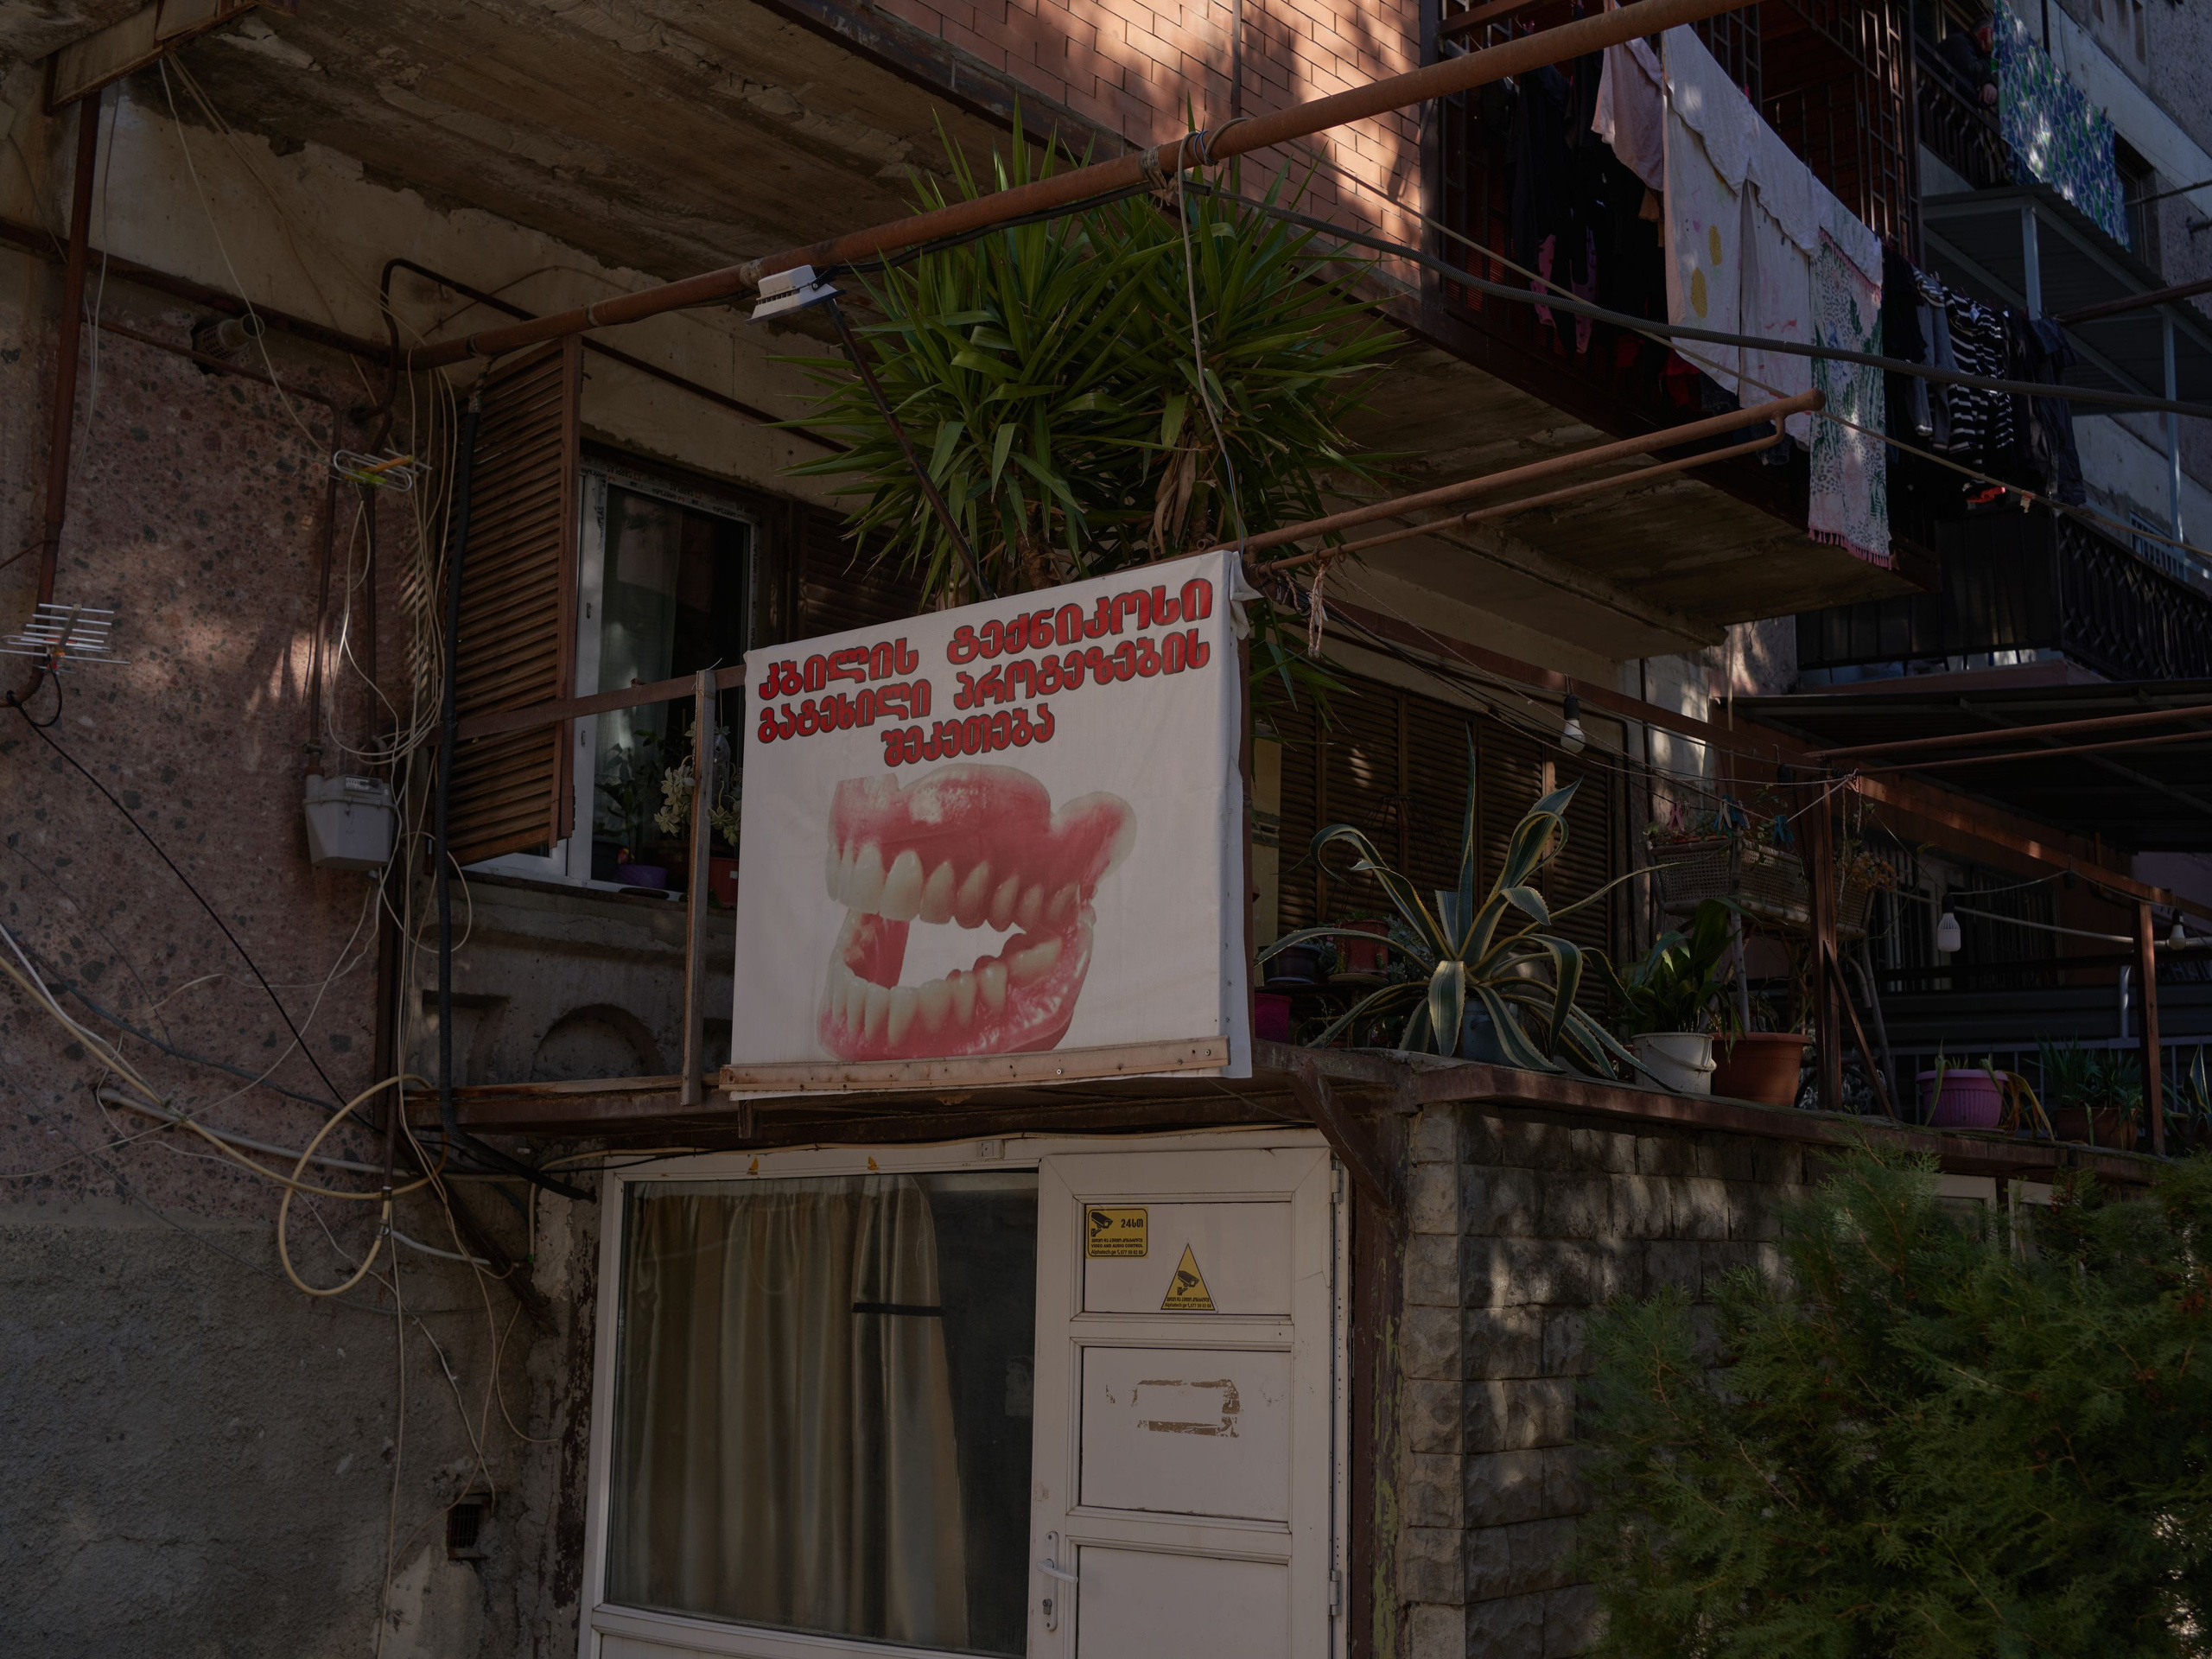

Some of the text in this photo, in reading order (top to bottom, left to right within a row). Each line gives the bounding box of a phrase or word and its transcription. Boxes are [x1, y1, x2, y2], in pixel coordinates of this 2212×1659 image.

[759, 577, 1214, 701] კბილის ტექნიკოსი
[757, 628, 1211, 743] გატეხილი პროტეზების
[880, 702, 1055, 767] შეკეთება
[1121, 1218, 1143, 1228] 24სთ
